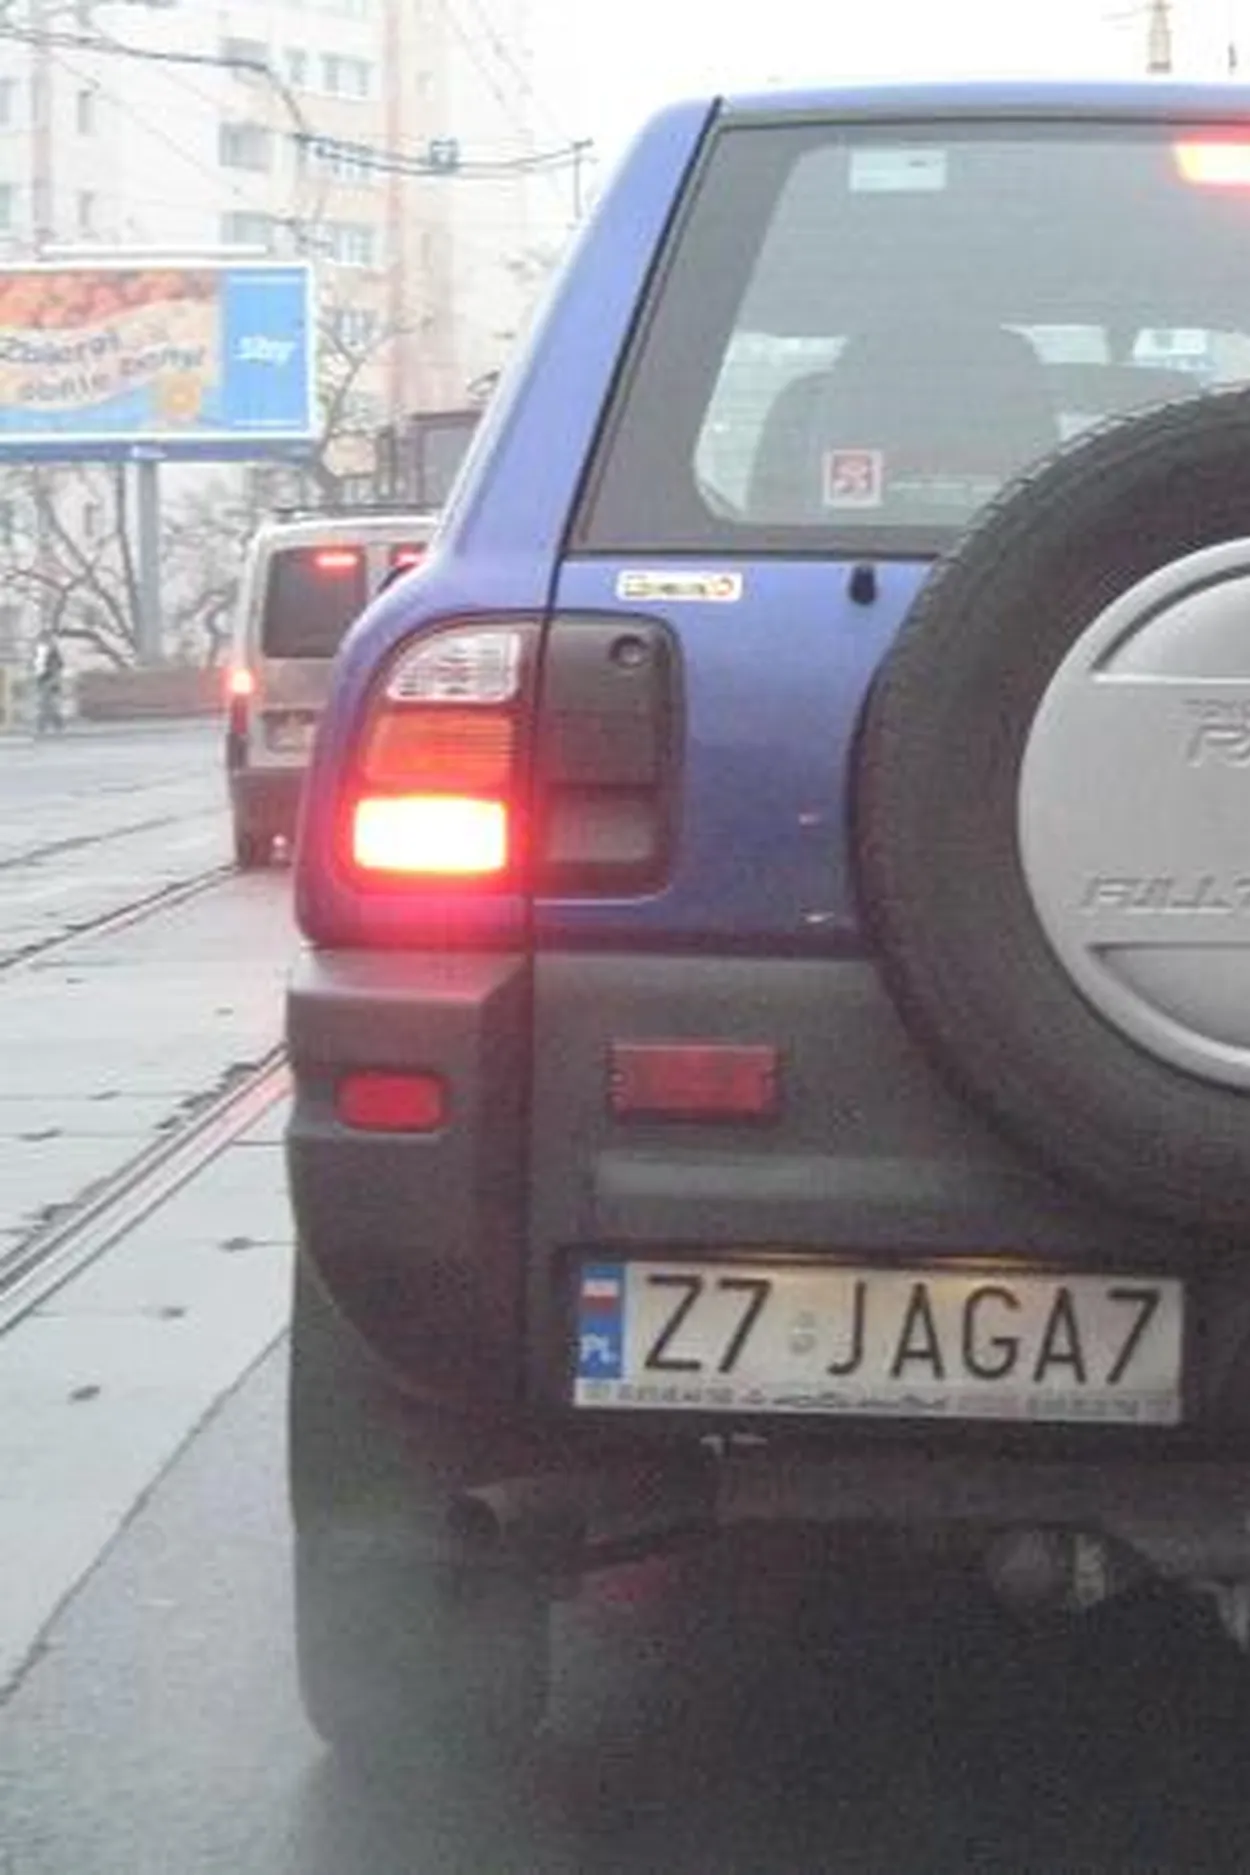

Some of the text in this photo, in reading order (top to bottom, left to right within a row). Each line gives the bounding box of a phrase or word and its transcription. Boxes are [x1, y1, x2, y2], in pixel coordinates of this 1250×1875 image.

[579, 1333, 613, 1365] PL
[643, 1274, 1161, 1386] Z7 JAGA7
